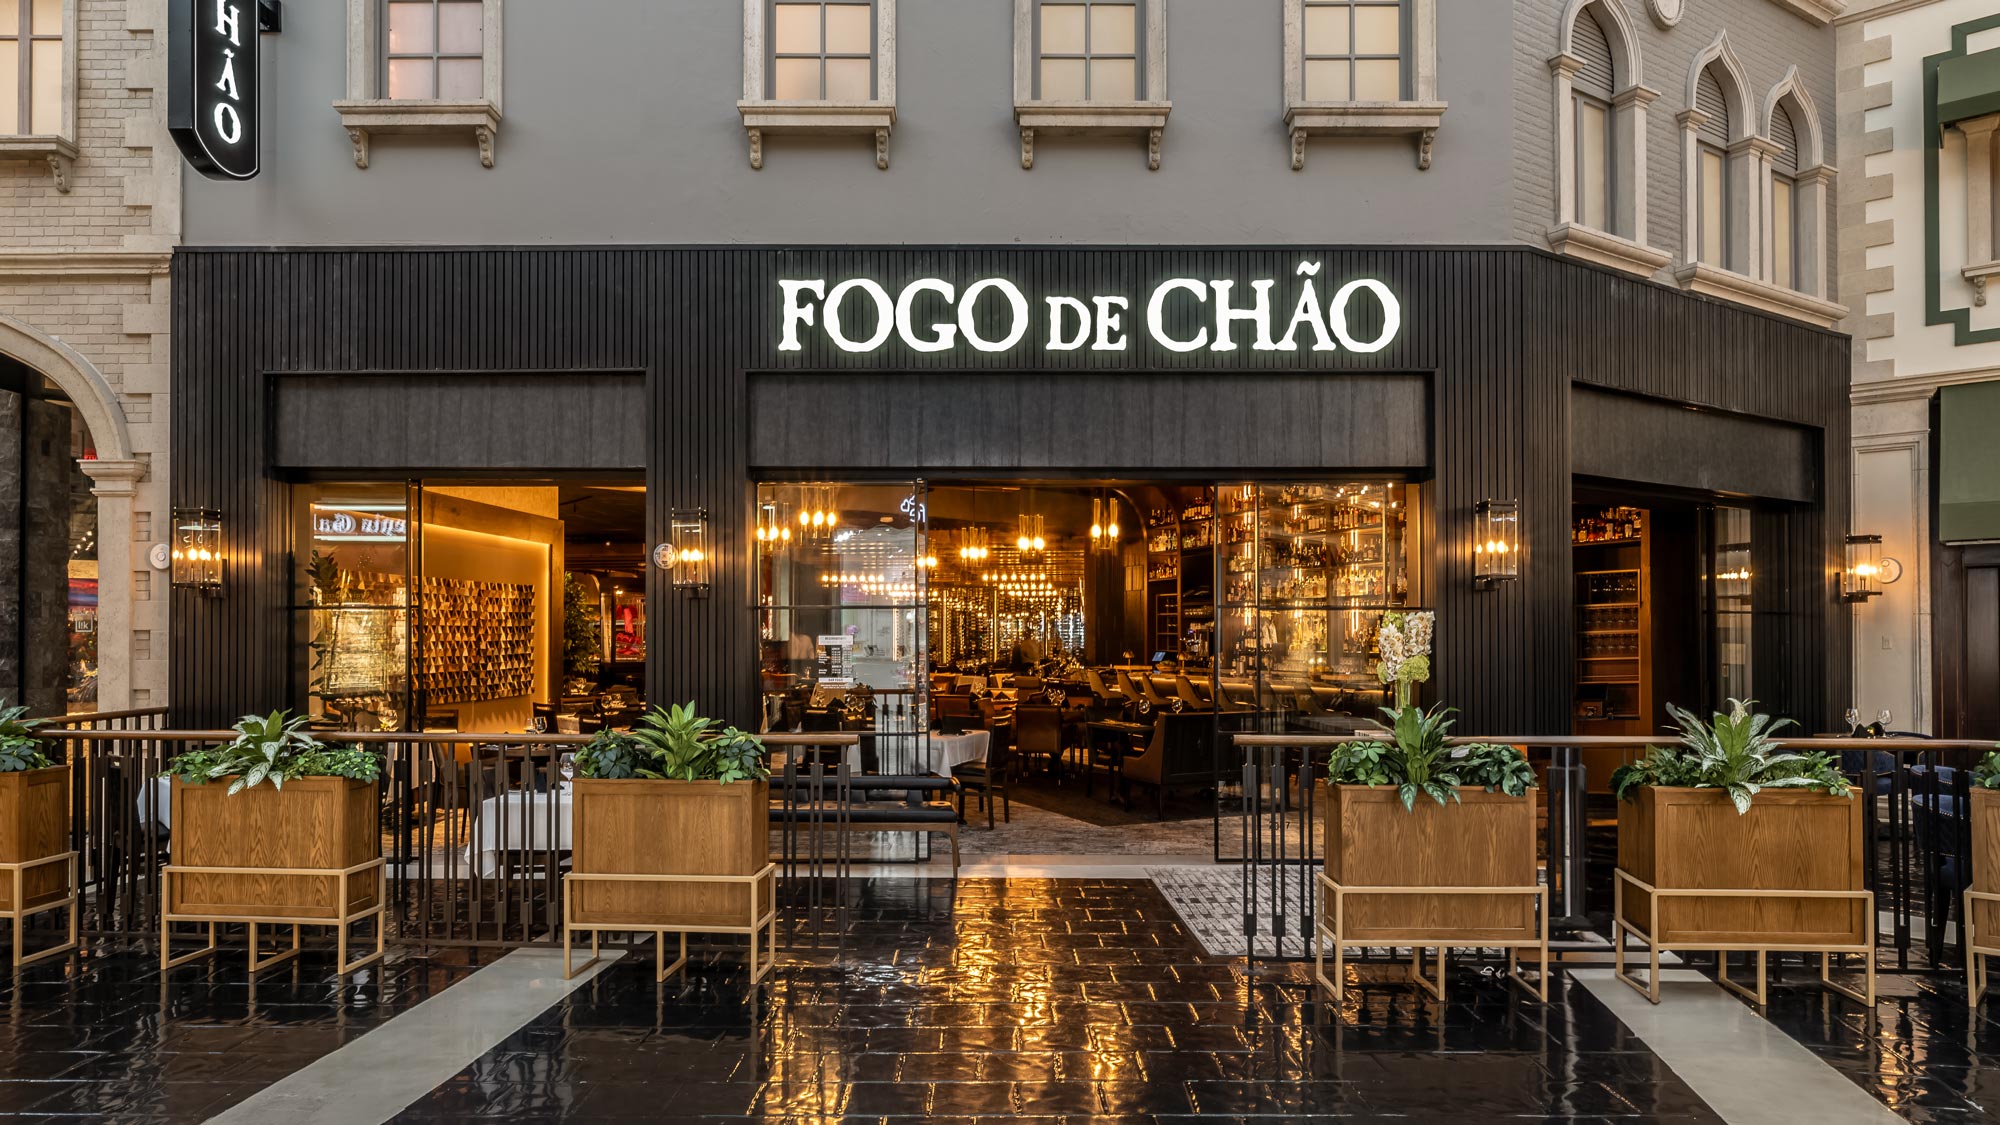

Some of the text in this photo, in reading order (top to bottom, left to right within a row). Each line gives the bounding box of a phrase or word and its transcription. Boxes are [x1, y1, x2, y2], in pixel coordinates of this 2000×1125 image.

[778, 260, 1402, 354] FOGO DE CHÃO
